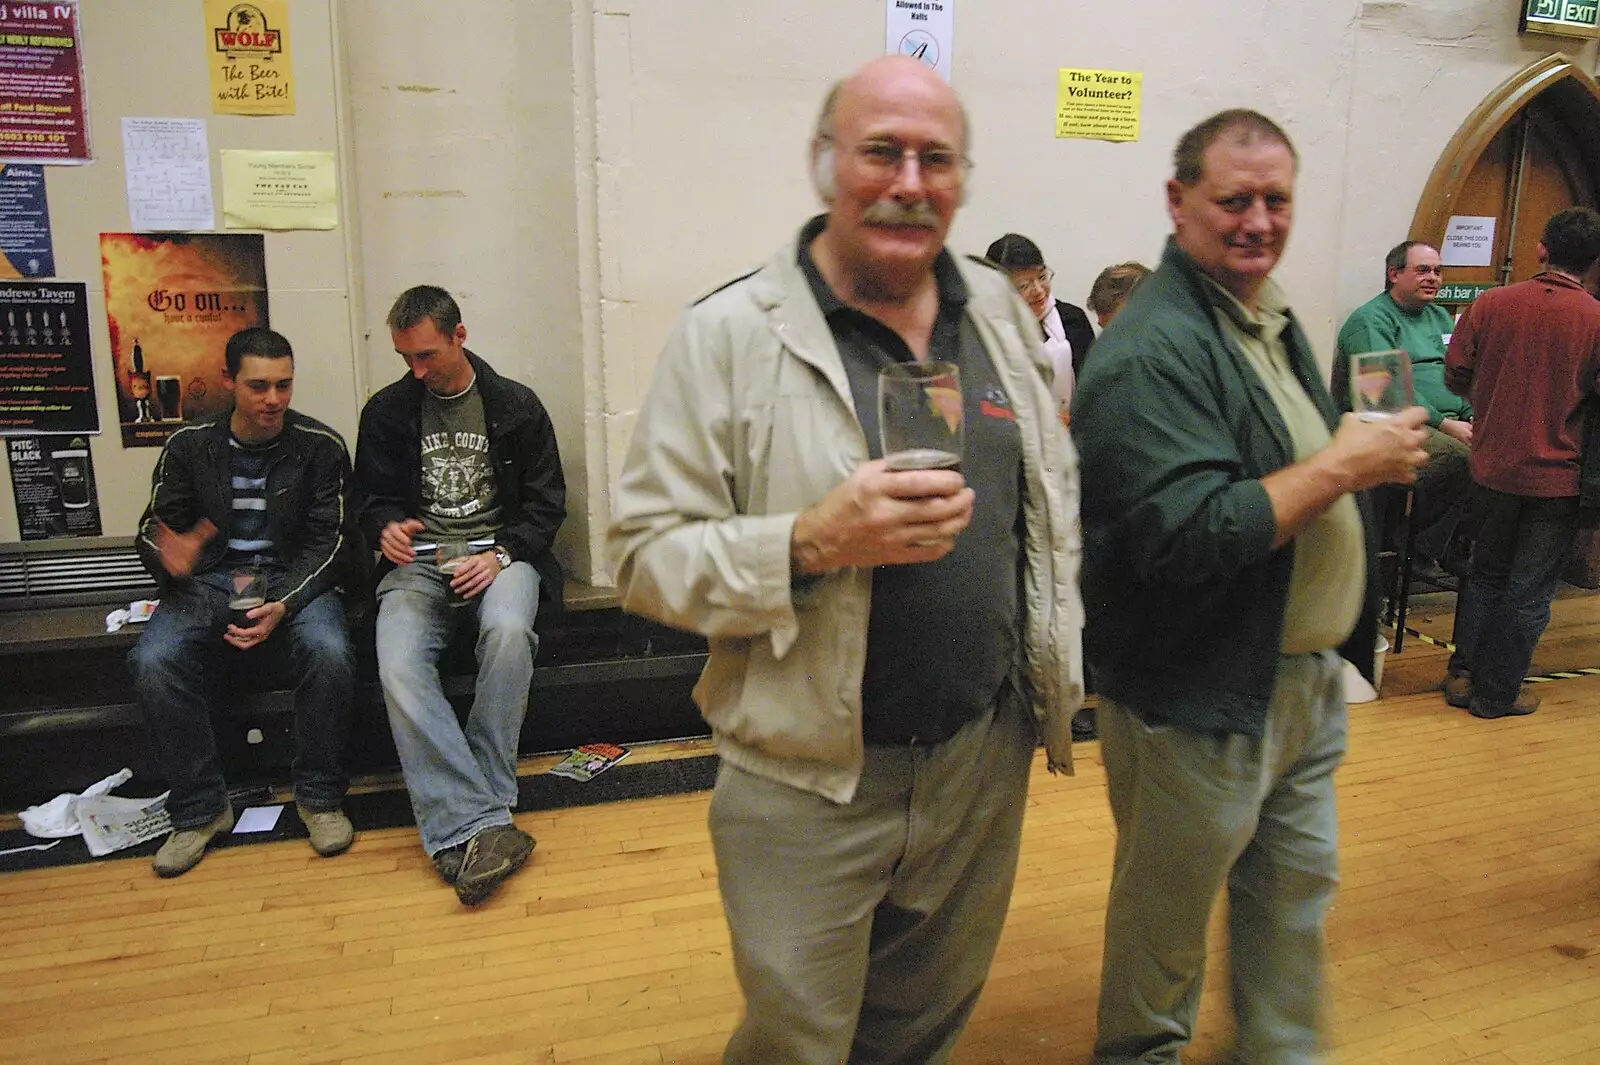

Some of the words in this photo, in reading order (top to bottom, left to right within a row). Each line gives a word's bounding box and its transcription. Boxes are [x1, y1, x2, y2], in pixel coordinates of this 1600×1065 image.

[895, 0, 922, 10] Allowed
[931, 3, 943, 11] The
[13, 6, 48, 20] villa
[54, 6, 71, 19] IV
[911, 12, 928, 21] Halls
[1566, 3, 1596, 23] EXIT
[219, 31, 277, 48] WOLF
[222, 65, 244, 81] The
[249, 64, 280, 81] Beer
[1069, 72, 1091, 82] The
[1095, 73, 1118, 84] Year
[1121, 76, 1132, 85] to
[218, 83, 249, 101] with
[255, 82, 288, 101] Bite!
[1068, 86, 1132, 100] Volunteer?
[38, 287, 75, 298] Tavern
[1454, 286, 1472, 299] bar
[148, 289, 185, 312] Go
[195, 292, 245, 312] on...
[11, 439, 40, 450] PITCH
[11, 450, 42, 461] BLACK
